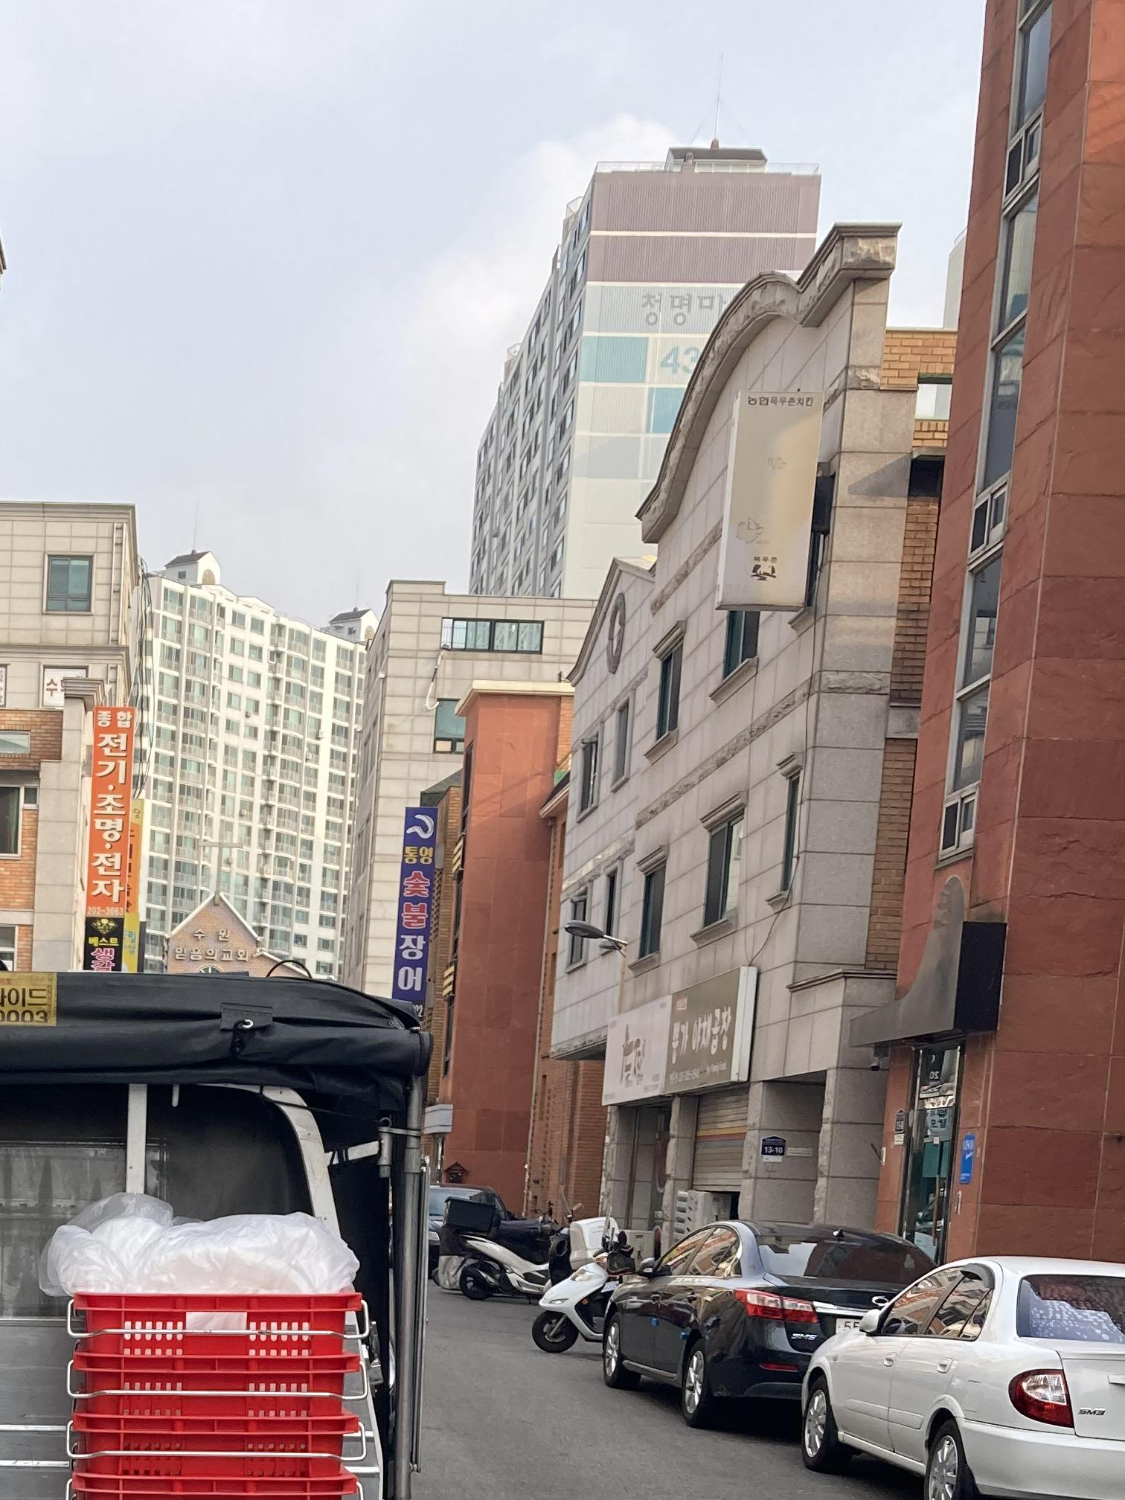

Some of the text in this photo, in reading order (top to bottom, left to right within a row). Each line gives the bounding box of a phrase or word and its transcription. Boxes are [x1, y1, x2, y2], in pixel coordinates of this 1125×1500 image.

[96, 710, 133, 729] 종합
[404, 845, 435, 865] 통영
[88, 936, 120, 947] 베스트
[1078, 1407, 1106, 1416] SM3
